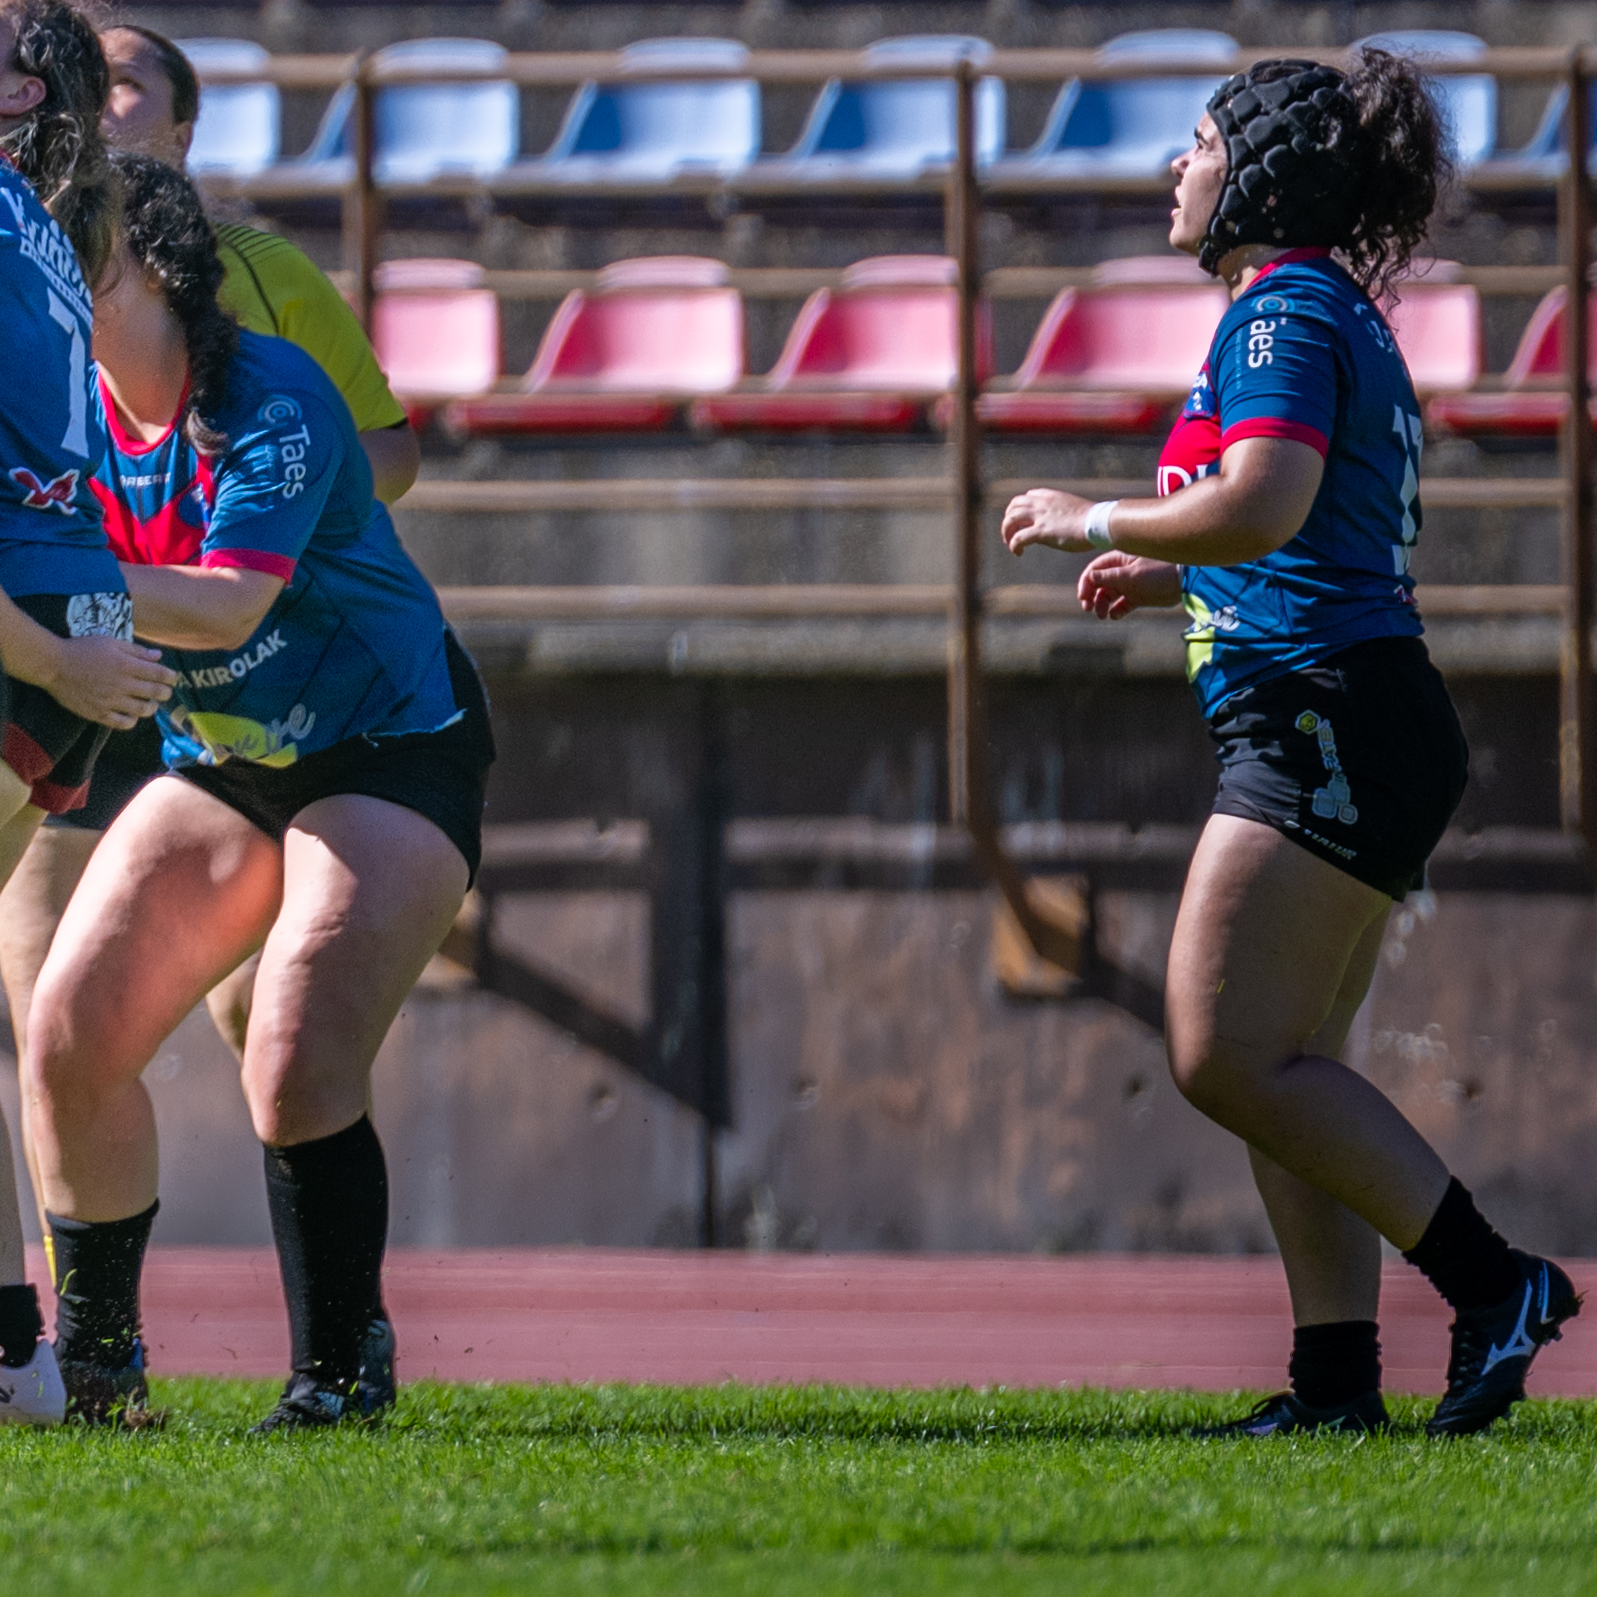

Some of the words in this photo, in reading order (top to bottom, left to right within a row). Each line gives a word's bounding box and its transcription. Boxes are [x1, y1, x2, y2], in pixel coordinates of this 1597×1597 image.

[1248, 316, 1287, 368] aes
[279, 423, 311, 499] Taes
[191, 628, 288, 688] KIROLAK
